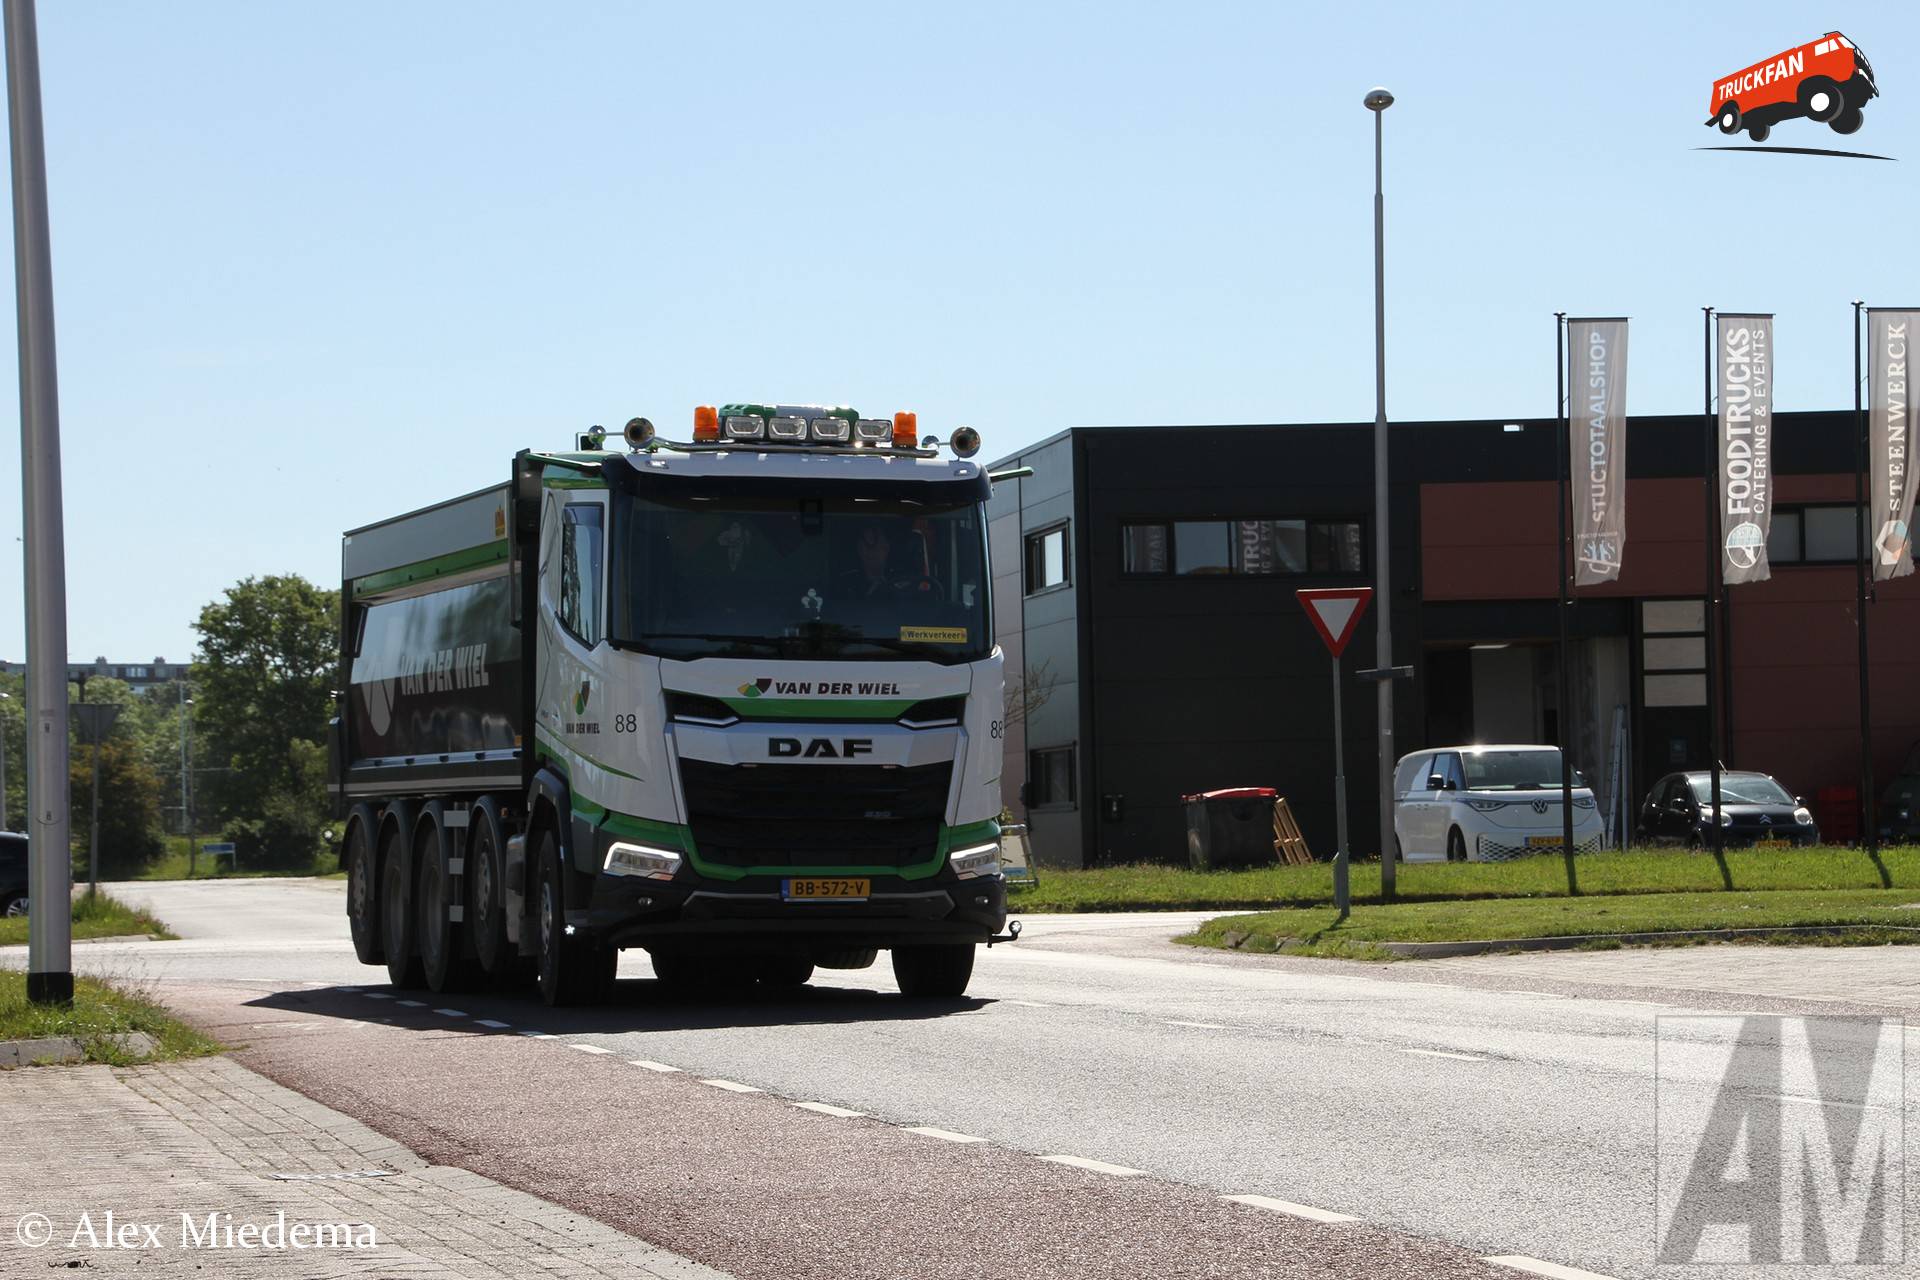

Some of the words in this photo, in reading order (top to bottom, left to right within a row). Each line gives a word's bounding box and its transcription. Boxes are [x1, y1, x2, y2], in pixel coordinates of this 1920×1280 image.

[1753, 329, 1766, 397] EVENTS
[1590, 332, 1606, 522] STUCTOTAALSHOP
[1726, 328, 1751, 515] FOODTRUCKS
[1754, 405, 1767, 417] &
[1887, 323, 1906, 511] STEENWERCK
[1753, 424, 1767, 514] CATERING
[1242, 520, 1260, 574] TRUC
[906, 630, 961, 640] Werkverkeer
[400, 655, 425, 695] VAN
[427, 649, 453, 693] DER
[455, 643, 489, 689] WIEL
[775, 682, 811, 695] VAN
[817, 682, 853, 695] DER
[858, 682, 901, 695] WIEL
[615, 713, 637, 733] 88
[768, 738, 873, 758] DAF
[795, 881, 864, 895] BB-572-V
